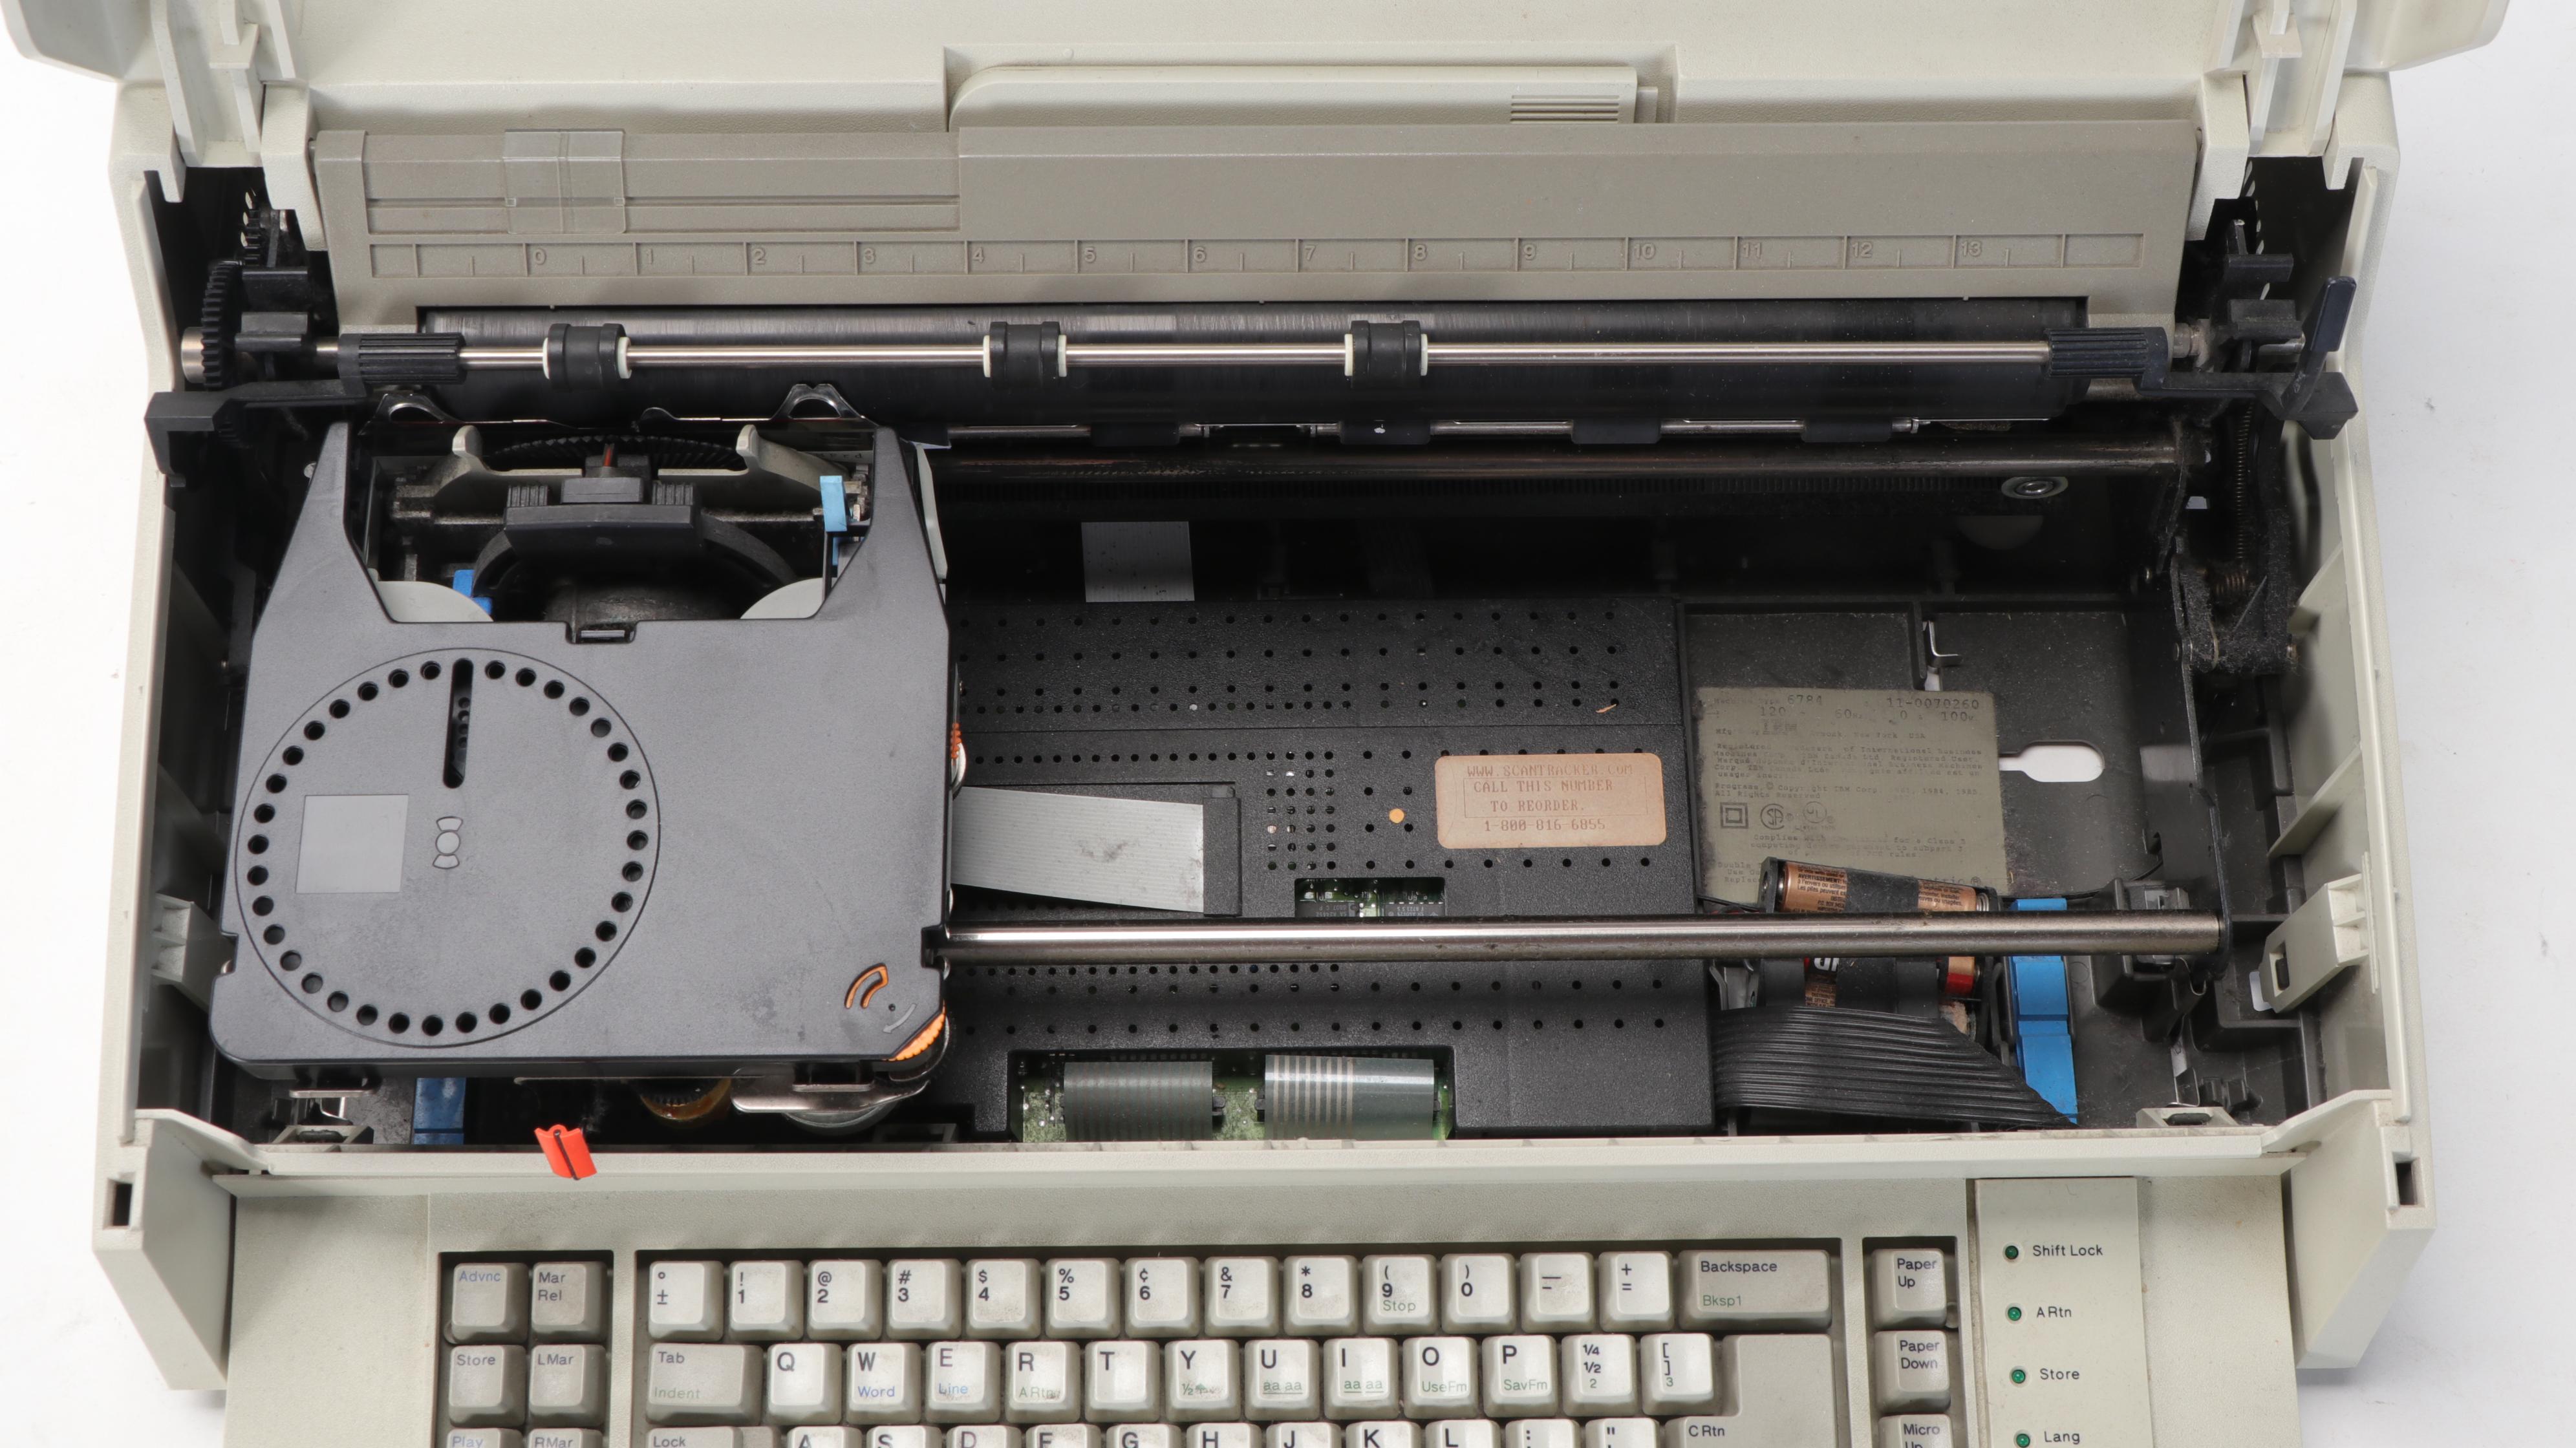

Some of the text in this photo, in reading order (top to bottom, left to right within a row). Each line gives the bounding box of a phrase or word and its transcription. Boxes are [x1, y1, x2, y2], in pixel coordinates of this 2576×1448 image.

[534, 241, 1982, 264] 0 1 2 3 4 5 6 7 8 9 10 11 12 13
[1787, 694, 1823, 705] 6784
[1887, 698, 1979, 709] 11-0070260
[1760, 706, 1787, 716] 120
[1474, 780, 1613, 793] CALL THIS NUMBER
[1491, 800, 1585, 812] TO REORDER.
[2033, 1244, 2103, 1256] Shift Lock
[1465, 1264, 1469, 1279] )
[1622, 1264, 1631, 1275] +
[1701, 1261, 1777, 1273] Backspace
[1897, 1258, 1935, 1271] Paper
[458, 1270, 500, 1281] Advnc
[539, 1272, 565, 1283] Mar
[740, 1272, 744, 1286] !
[818, 1271, 832, 1286] @
[899, 1270, 911, 1284] #
[979, 1270, 987, 1284] $
[1058, 1268, 1074, 1283] %
[1139, 1268, 1148, 1283] ¢
[1221, 1266, 1232, 1281] &
[1384, 1266, 1388, 1280] (
[1898, 1276, 1915, 1288] Up
[538, 1290, 562, 1301] Rel
[738, 1290, 744, 1303] 1
[817, 1289, 828, 1303] 2
[898, 1288, 908, 1302] 3
[978, 1287, 989, 1301] 4
[1059, 1286, 1069, 1301] 5
[1140, 1286, 1150, 1300] 6
[1221, 1284, 1231, 1299] 7
[1302, 1284, 1313, 1298] 8
[1382, 1283, 1393, 1297] 9
[1461, 1283, 1473, 1297] 0
[1383, 1297, 1415, 1312] Stop
[1703, 1295, 1741, 1307] Bksp1
[1662, 1343, 1669, 1358] [
[1900, 1340, 1938, 1353] Paper
[456, 1354, 496, 1366] Store
[537, 1354, 574, 1365] LMar
[658, 1351, 685, 1363] Tab
[777, 1352, 795, 1371] Q
[857, 1352, 875, 1371] W
[940, 1348, 953, 1367] E
[1019, 1352, 1033, 1371] R
[1100, 1351, 1115, 1370] T
[1181, 1350, 1196, 1369] Y
[1261, 1350, 1276, 1368] U
[1342, 1348, 1346, 1367] I
[1422, 1347, 1439, 1366] O
[1503, 1345, 1517, 1364] P
[1664, 1360, 1670, 1376] ]
[1901, 1357, 1938, 1369] Down
[2040, 1368, 2079, 1380] Store
[1421, 1378, 1466, 1394] UseFm
[1504, 1379, 1547, 1391] SavFm
[1590, 1378, 1596, 1389] 2
[1666, 1377, 1673, 1387] 3
[654, 1387, 701, 1398] Indent
[857, 1386, 895, 1399] Word
[937, 1383, 967, 1399] Line
[1904, 1423, 1940, 1435] Micro
[452, 1436, 482, 1448] Play
[535, 1436, 573, 1448] RMar
[653, 1436, 685, 1447] Lock
[799, 1434, 810, 1448] A
[877, 1434, 890, 1448] S
[960, 1431, 976, 1448] D
[1039, 1432, 1053, 1448] F
[1122, 1432, 1138, 1448] G
[1203, 1431, 1218, 1448] H
[1284, 1431, 1294, 1448] J
[1364, 1429, 1380, 1448] K
[1445, 1429, 1458, 1447] L
[2045, 1431, 2080, 1445] Lang
